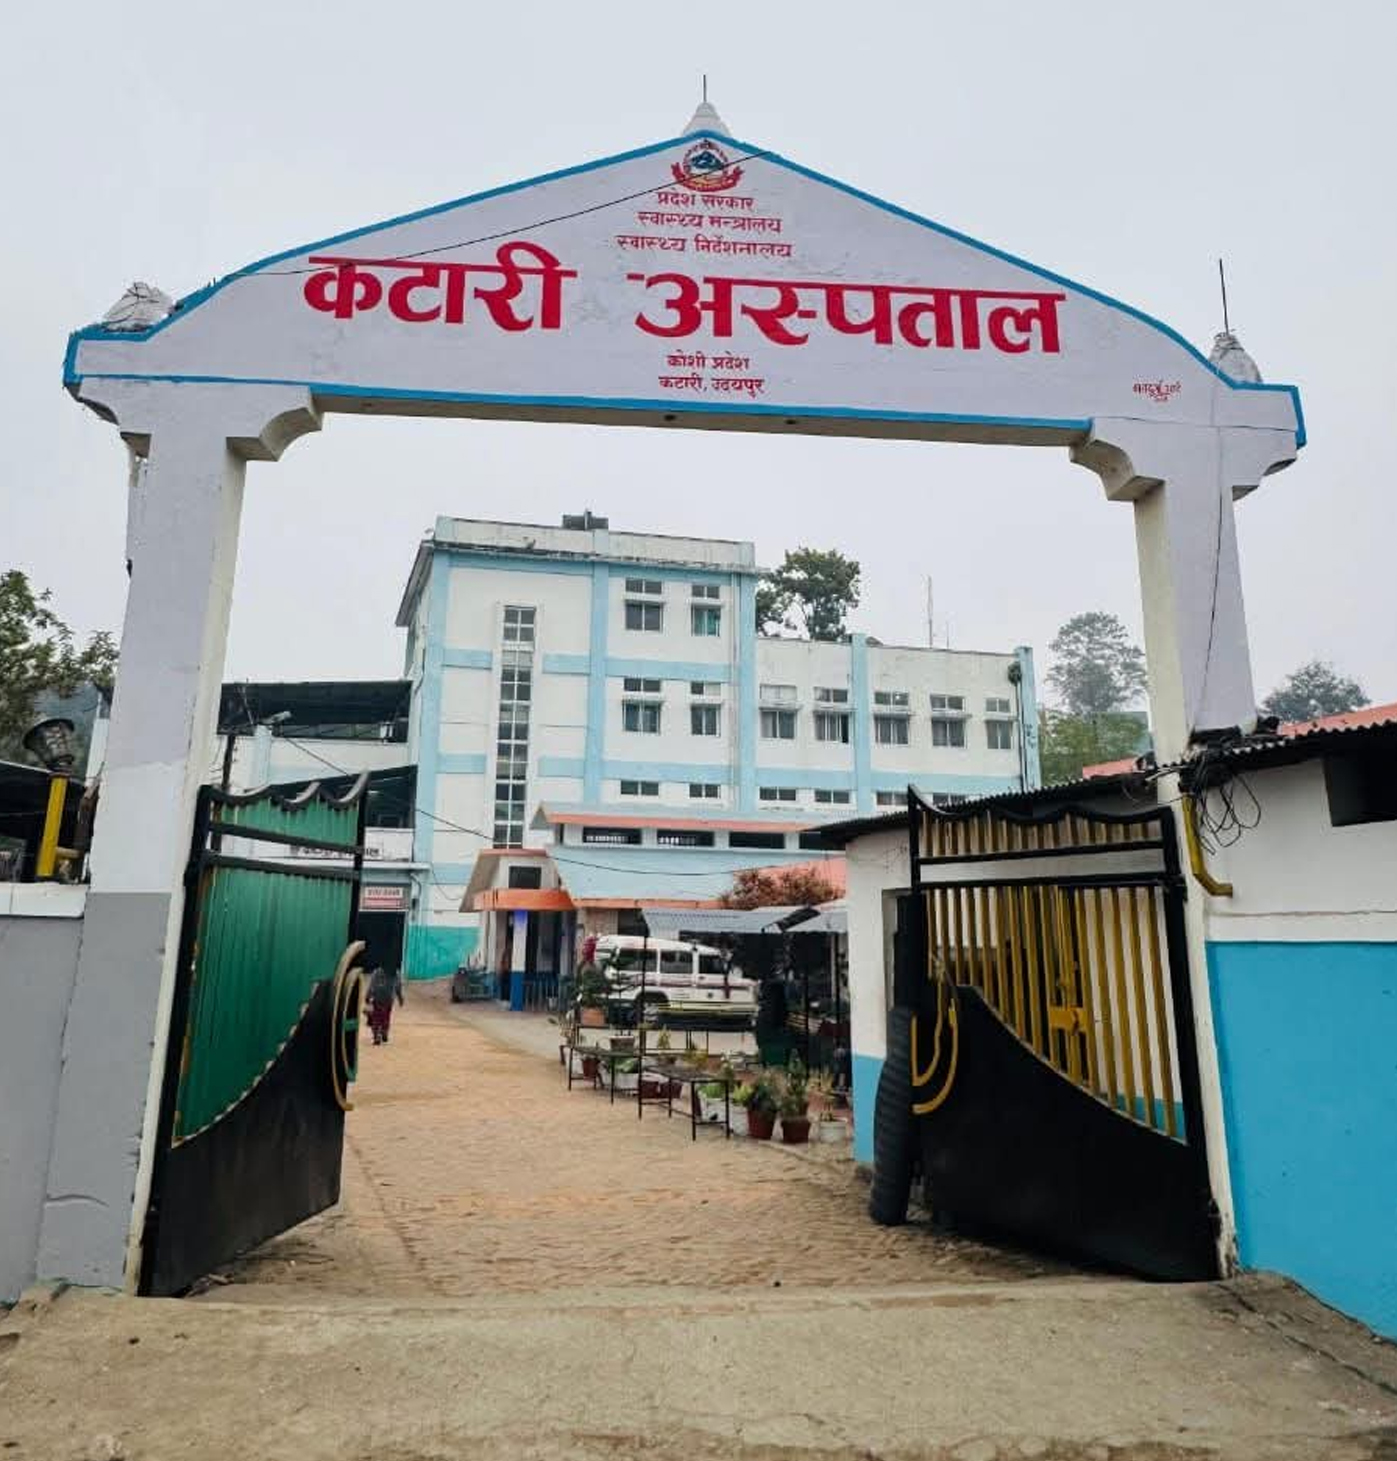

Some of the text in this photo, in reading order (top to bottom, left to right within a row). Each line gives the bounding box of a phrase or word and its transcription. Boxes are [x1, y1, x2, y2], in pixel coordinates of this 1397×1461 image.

[657, 187, 755, 210] प्रदेश सरकार
[637, 211, 782, 233] स्वास्थ्य मन्त्रालय
[615, 235, 686, 251] स्वास्थ्य
[303, 241, 1067, 355] कटारी अस्पताल
[667, 350, 749, 370] कोशी प्रदेश
[711, 377, 766, 398] उदयपुर
